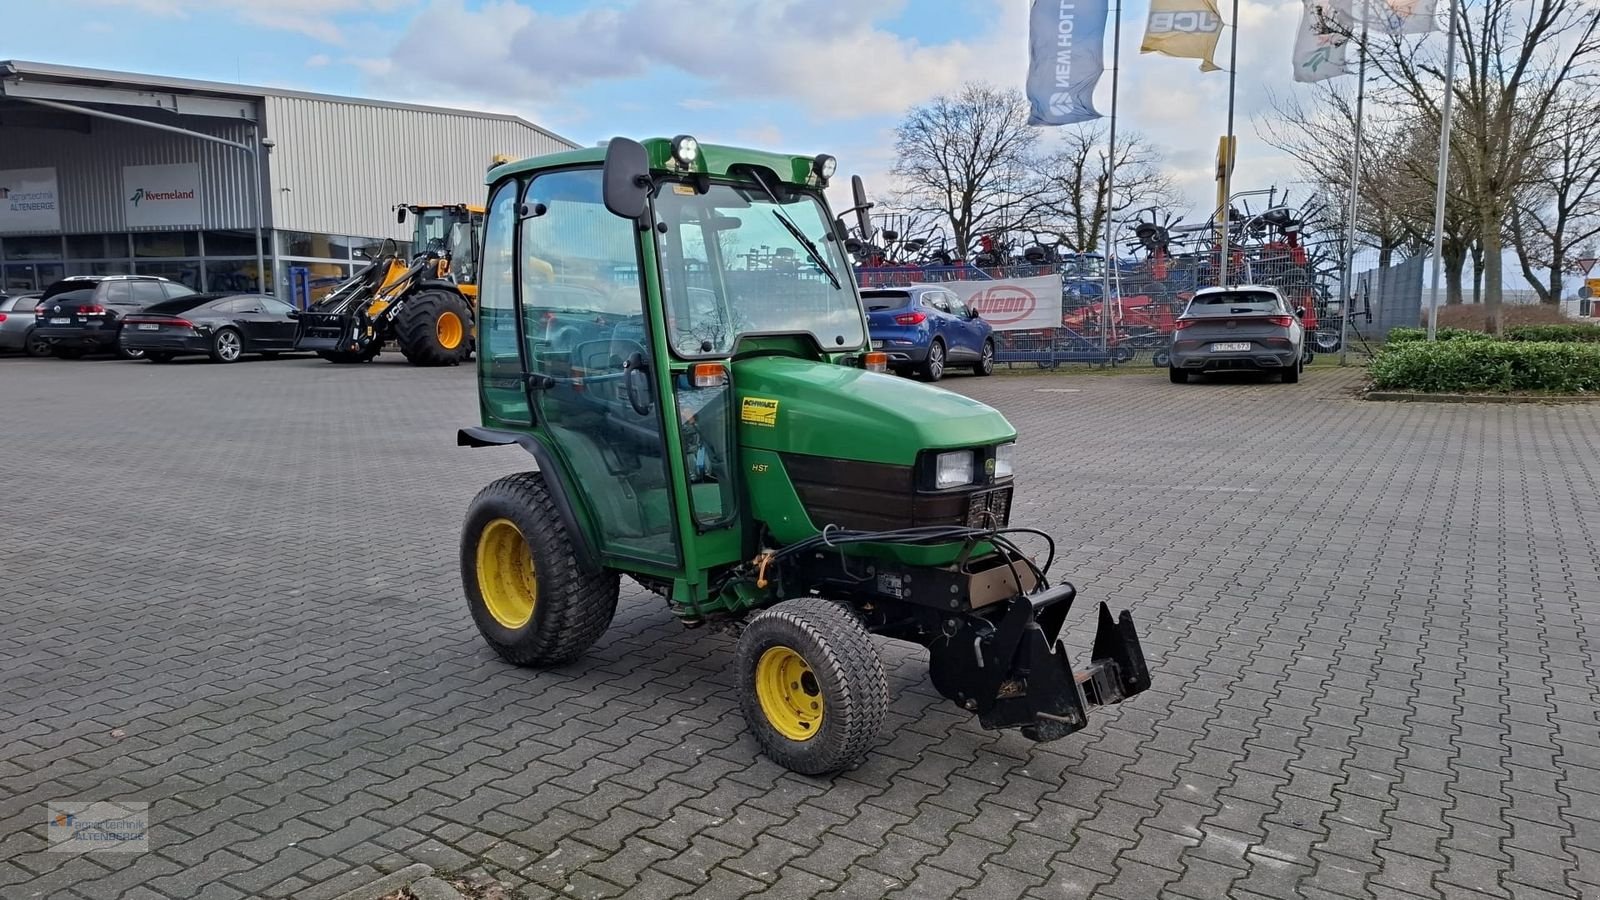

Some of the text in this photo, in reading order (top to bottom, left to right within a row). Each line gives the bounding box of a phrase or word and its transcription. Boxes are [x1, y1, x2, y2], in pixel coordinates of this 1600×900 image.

[145, 188, 194, 200] Kverneland
[10, 202, 56, 211] ALTENBERGE
[977, 290, 1028, 314] Vicon
[752, 463, 769, 472] HST
